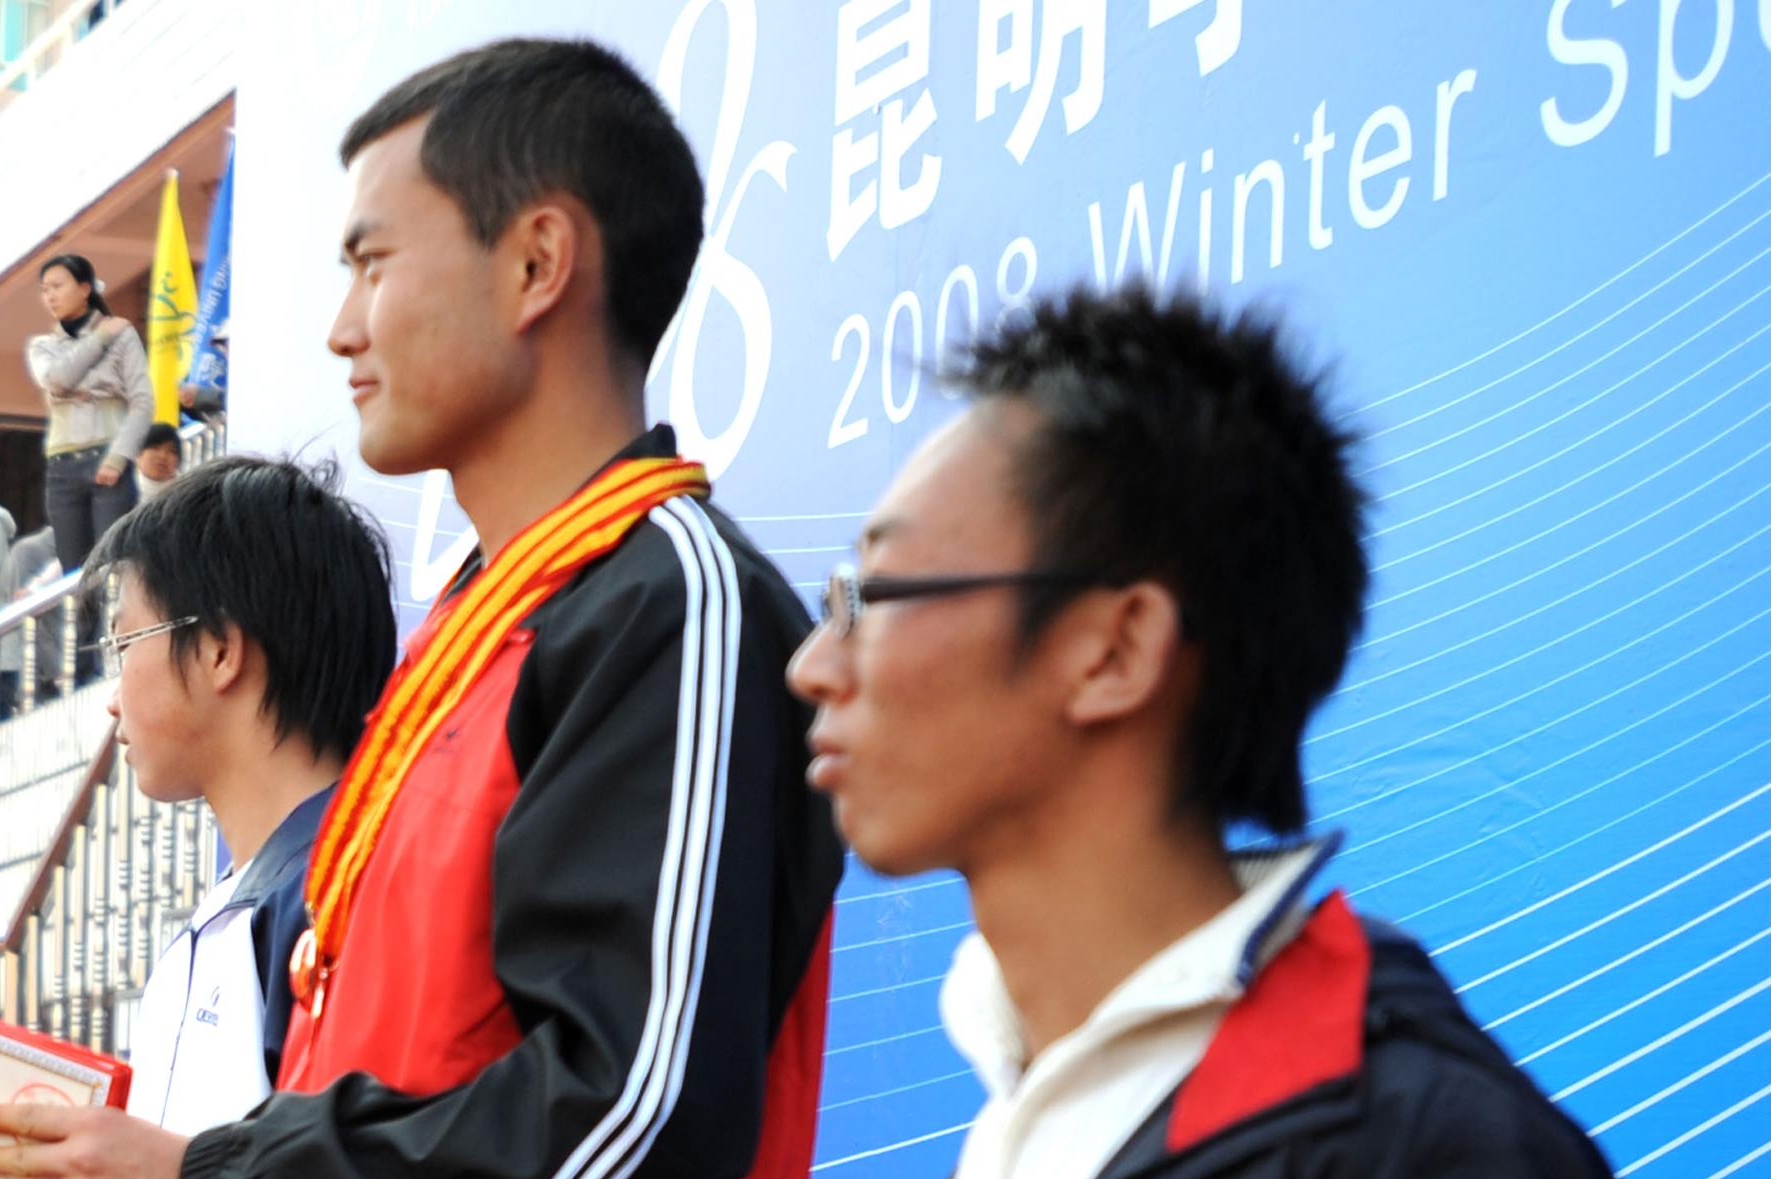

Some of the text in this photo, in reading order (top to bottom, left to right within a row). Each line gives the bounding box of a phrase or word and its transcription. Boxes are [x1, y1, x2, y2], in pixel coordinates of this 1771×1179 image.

[826, 0, 1243, 263] 昆明
[1087, 68, 1478, 304] Winter
[1539, 0, 1771, 158] Sp
